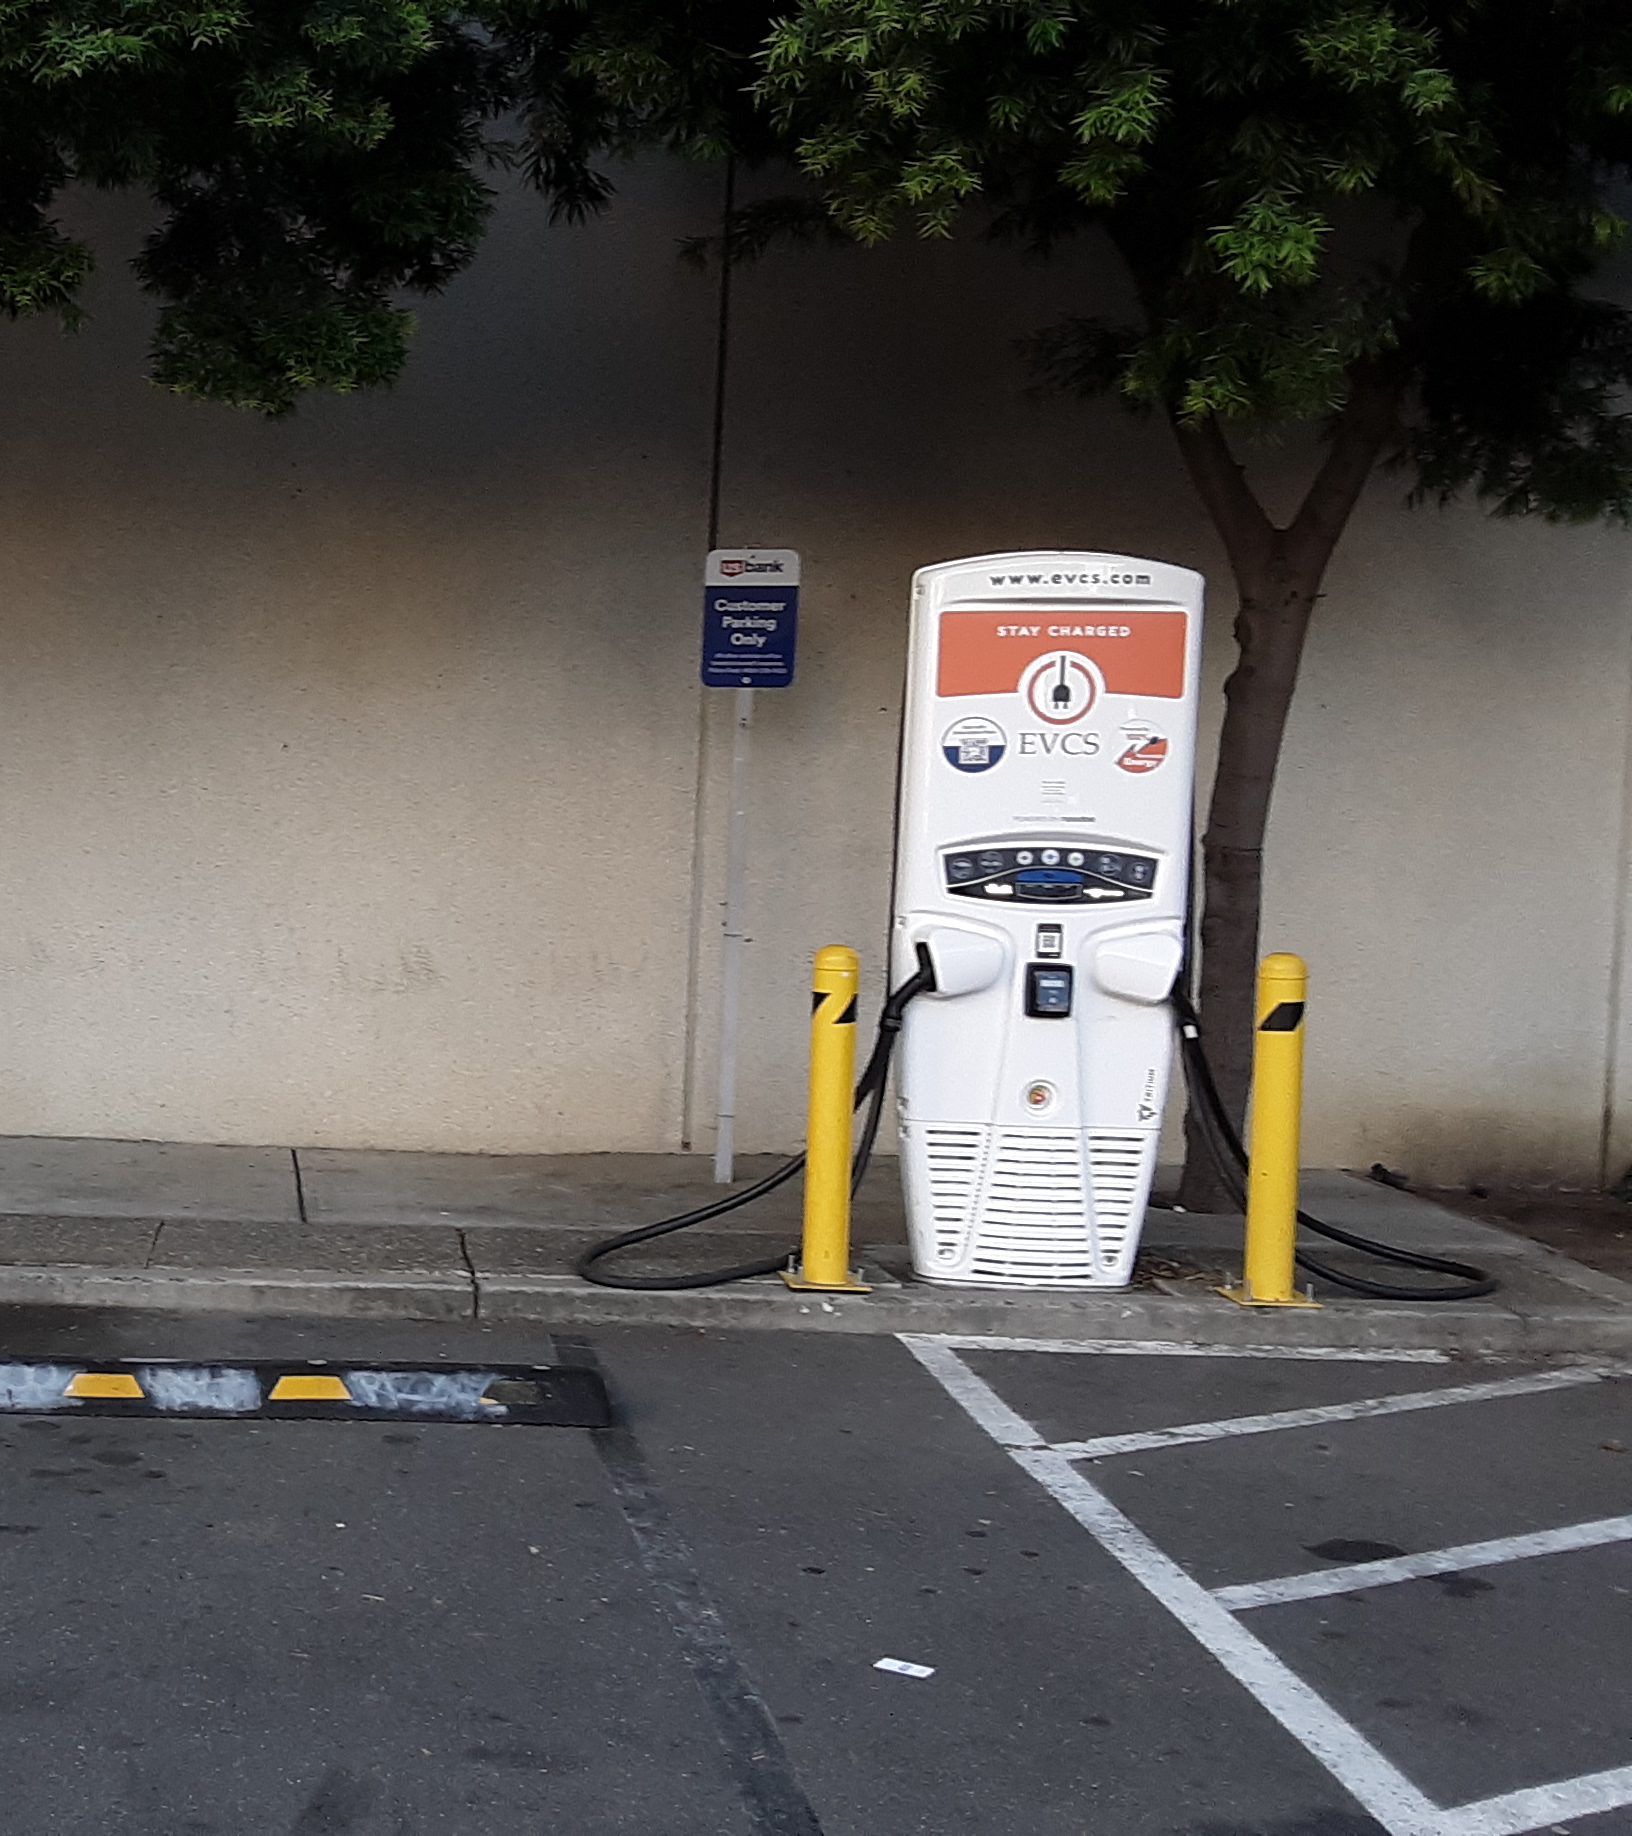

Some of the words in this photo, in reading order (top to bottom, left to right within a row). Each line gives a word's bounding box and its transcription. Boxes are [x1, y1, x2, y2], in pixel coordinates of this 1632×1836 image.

[989, 572, 1151, 586] www.evcs.com
[714, 599, 787, 612] Customer
[722, 615, 777, 631] Parking
[996, 625, 1041, 637] STAY
[1048, 625, 1132, 637] CHARGED
[730, 633, 767, 648] Only
[1018, 732, 1100, 755] EVCS
